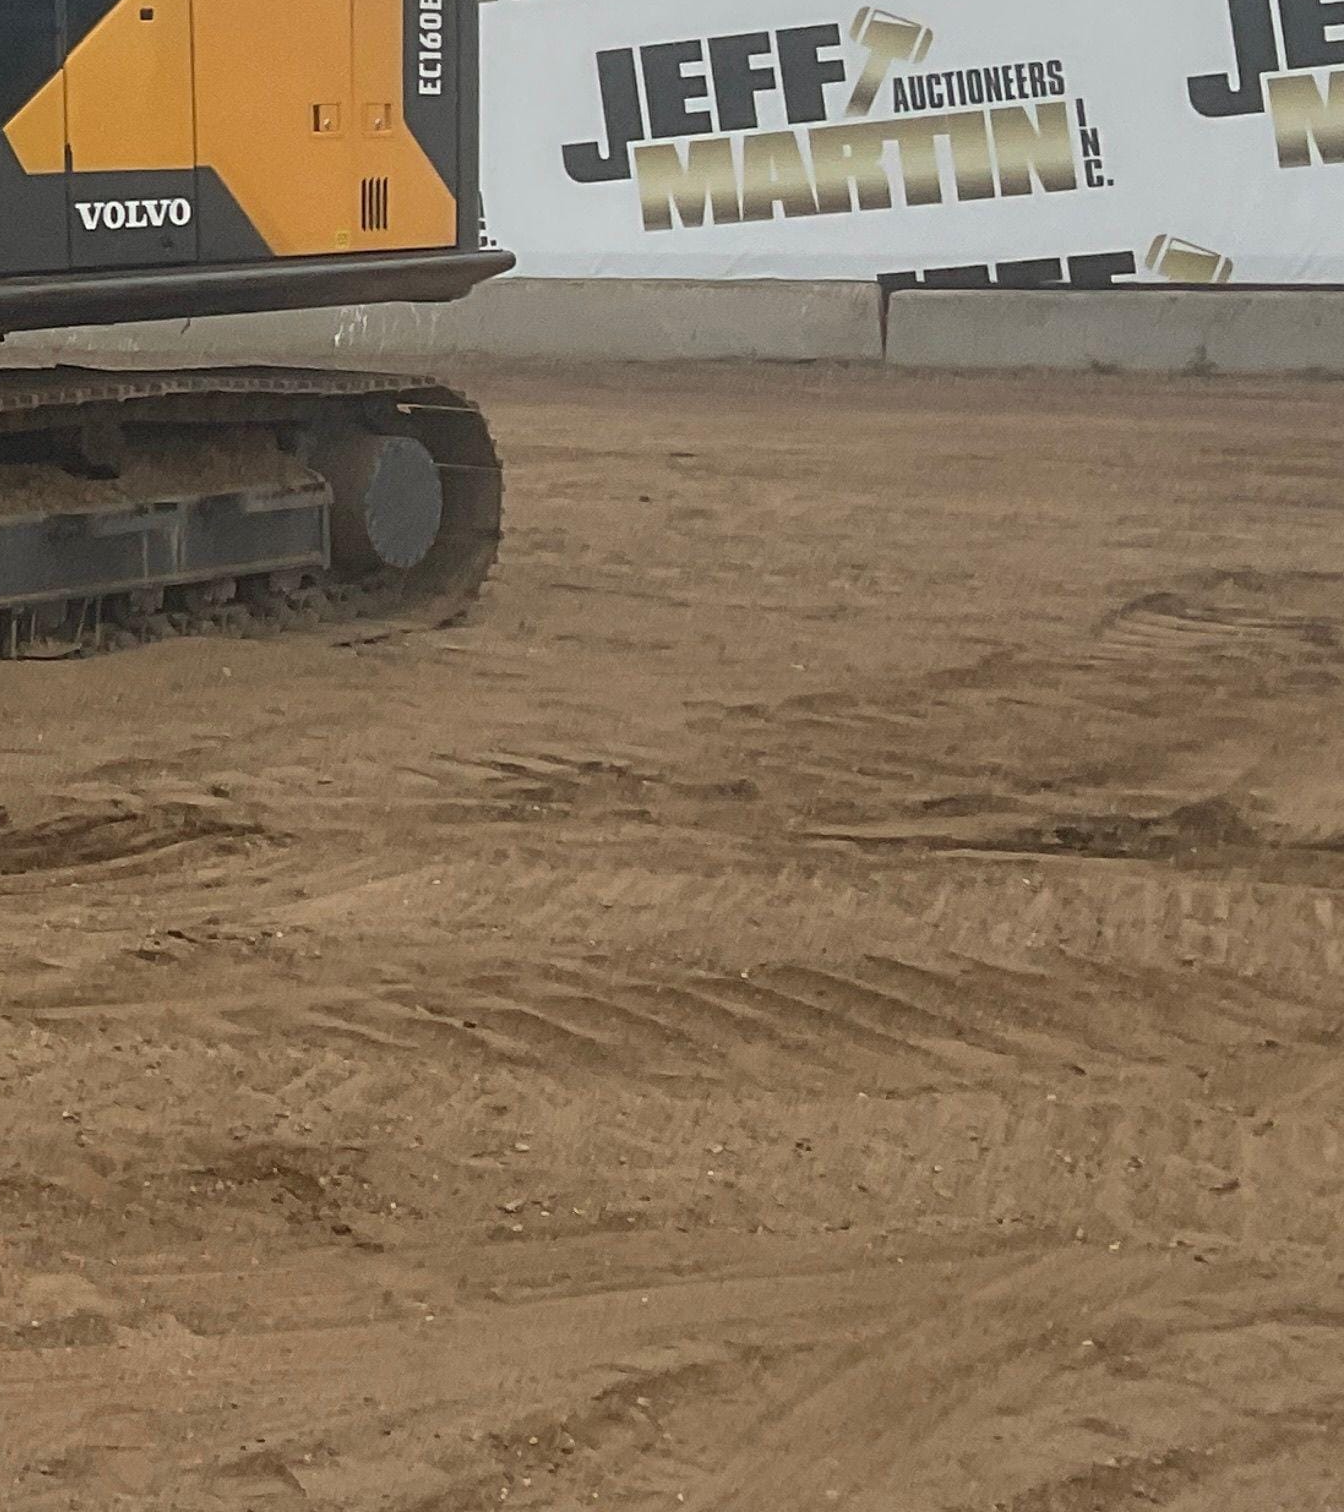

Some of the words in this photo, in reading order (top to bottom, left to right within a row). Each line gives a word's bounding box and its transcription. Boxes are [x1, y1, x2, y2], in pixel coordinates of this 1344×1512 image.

[561, 23, 847, 184] JEFF
[893, 59, 1066, 113] AUCTIONEERS
[633, 100, 1078, 232] MARTIN
[74, 197, 192, 230] VOLVO
